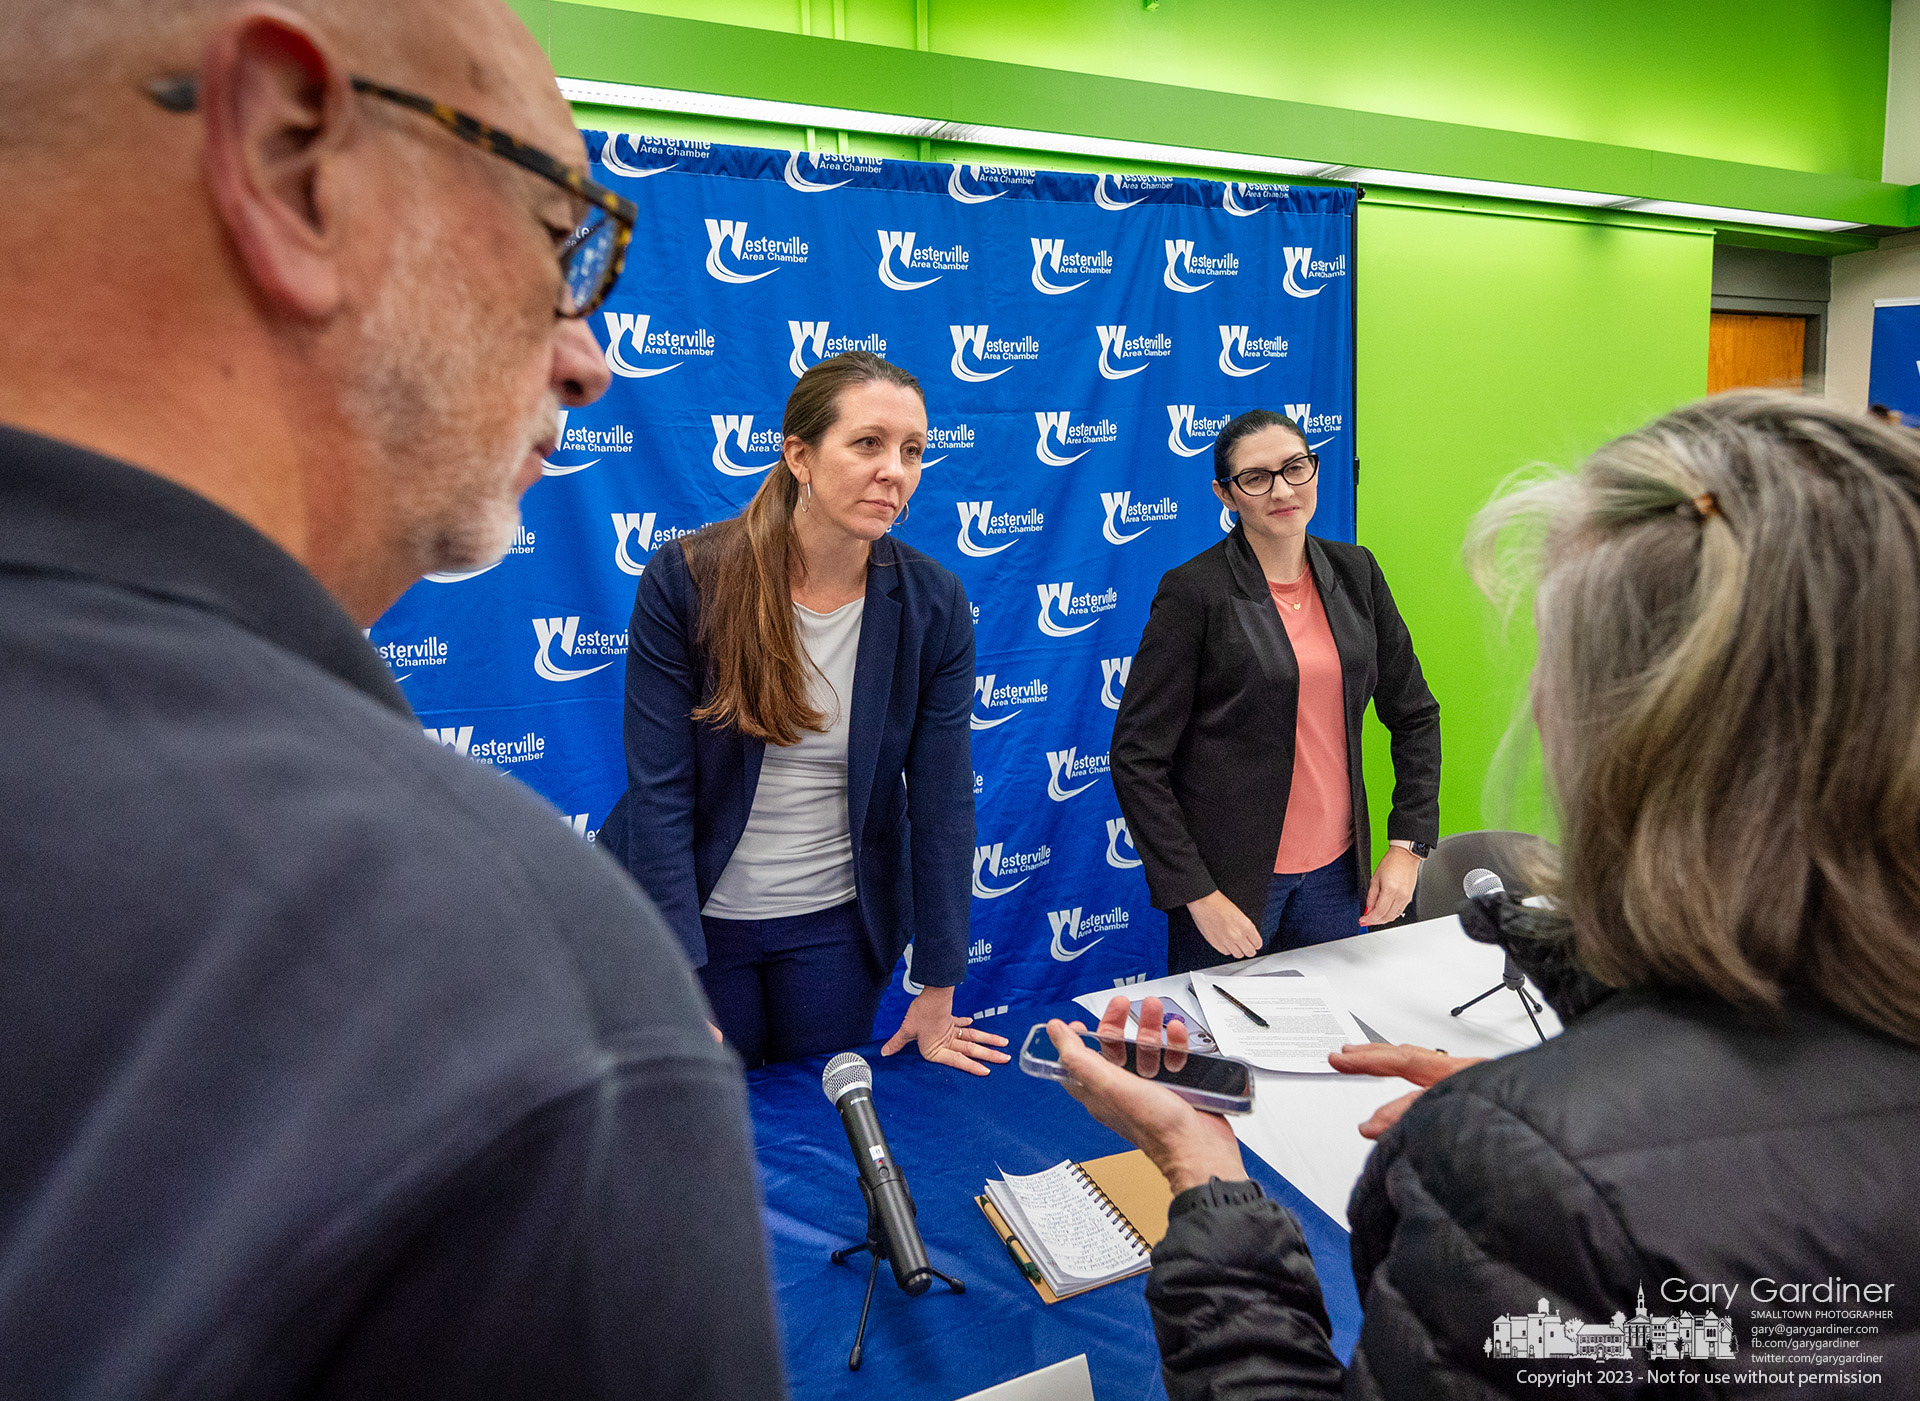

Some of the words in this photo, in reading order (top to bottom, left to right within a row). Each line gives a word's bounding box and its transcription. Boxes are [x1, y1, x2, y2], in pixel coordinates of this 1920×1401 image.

[640, 144, 663, 155] Area
[666, 146, 710, 159] Chamber
[819, 162, 841, 171] Area
[842, 163, 882, 174] Chamber
[979, 173, 999, 182] Area
[1000, 175, 1035, 185] Chamber
[1122, 182, 1139, 190] Area
[1140, 182, 1173, 190] Chamber
[1245, 190, 1261, 198] Area
[704, 219, 809, 261] Westerville
[877, 230, 969, 269] Westerville
[1030, 237, 1113, 274] Westerville
[742, 251, 765, 261] Area
[767, 252, 808, 263] Chamber
[1165, 239, 1239, 274] Westerville
[910, 260, 931, 269] Area
[932, 261, 969, 271] Chamber
[1283, 247, 1346, 279] Wesrvill
[1060, 265, 1078, 274] Area
[1080, 266, 1112, 274] Chamber
[1189, 267, 1205, 275] Area
[1206, 266, 1238, 276] Chamber
[1321, 270, 1346, 279] hamb
[603, 312, 715, 355] Westerville
[788, 320, 887, 359] Westerville
[949, 325, 1039, 361] Westerville
[644, 346, 667, 355] Area
[670, 346, 714, 356] Chamber
[824, 350, 840, 358] Are
[983, 352, 1000, 360] Area
[1002, 351, 1039, 360] Chamber
[1122, 350, 1142, 358] Area
[1166, 404, 1231, 438] Westervil
[1284, 403, 1342, 434] Westerv
[927, 424, 975, 441] sterville
[1034, 411, 1117, 446] Westerville
[937, 440, 974, 449] Chamber
[1066, 437, 1082, 445] Area
[1082, 435, 1117, 444] Chamber
[563, 441, 586, 451] Area
[587, 442, 633, 452] Chamber
[748, 444, 770, 453] Area
[1100, 490, 1178, 524] Westerville
[956, 500, 1044, 536] Westerville
[1125, 515, 1140, 523] Area
[1141, 512, 1178, 522] Chamber
[988, 526, 1007, 535] Area
[1008, 524, 1043, 534] Chamber
[506, 546, 535, 555] mber
[1036, 581, 1117, 616] Westerville
[1069, 607, 1089, 615] Area
[532, 616, 628, 657] Westervi
[373, 636, 448, 660] sterville
[574, 646, 598, 655] Area
[600, 646, 628, 655] Cham
[395, 657, 447, 668] Chamber
[990, 699, 1009, 707] Area
[1010, 695, 1048, 705] Chamber
[496, 752, 545, 764] Chamber
[1046, 746, 1110, 780] Westervi
[1071, 770, 1087, 778] Area
[1089, 766, 1111, 774] Cham
[973, 842, 1051, 878] Westerville
[999, 868, 1018, 876] Area
[1020, 859, 1051, 872] Chamber
[1047, 907, 1129, 941] Westerville
[1077, 929, 1093, 938] Area
[1094, 922, 1129, 932] Chamber
[968, 954, 991, 965] mber
